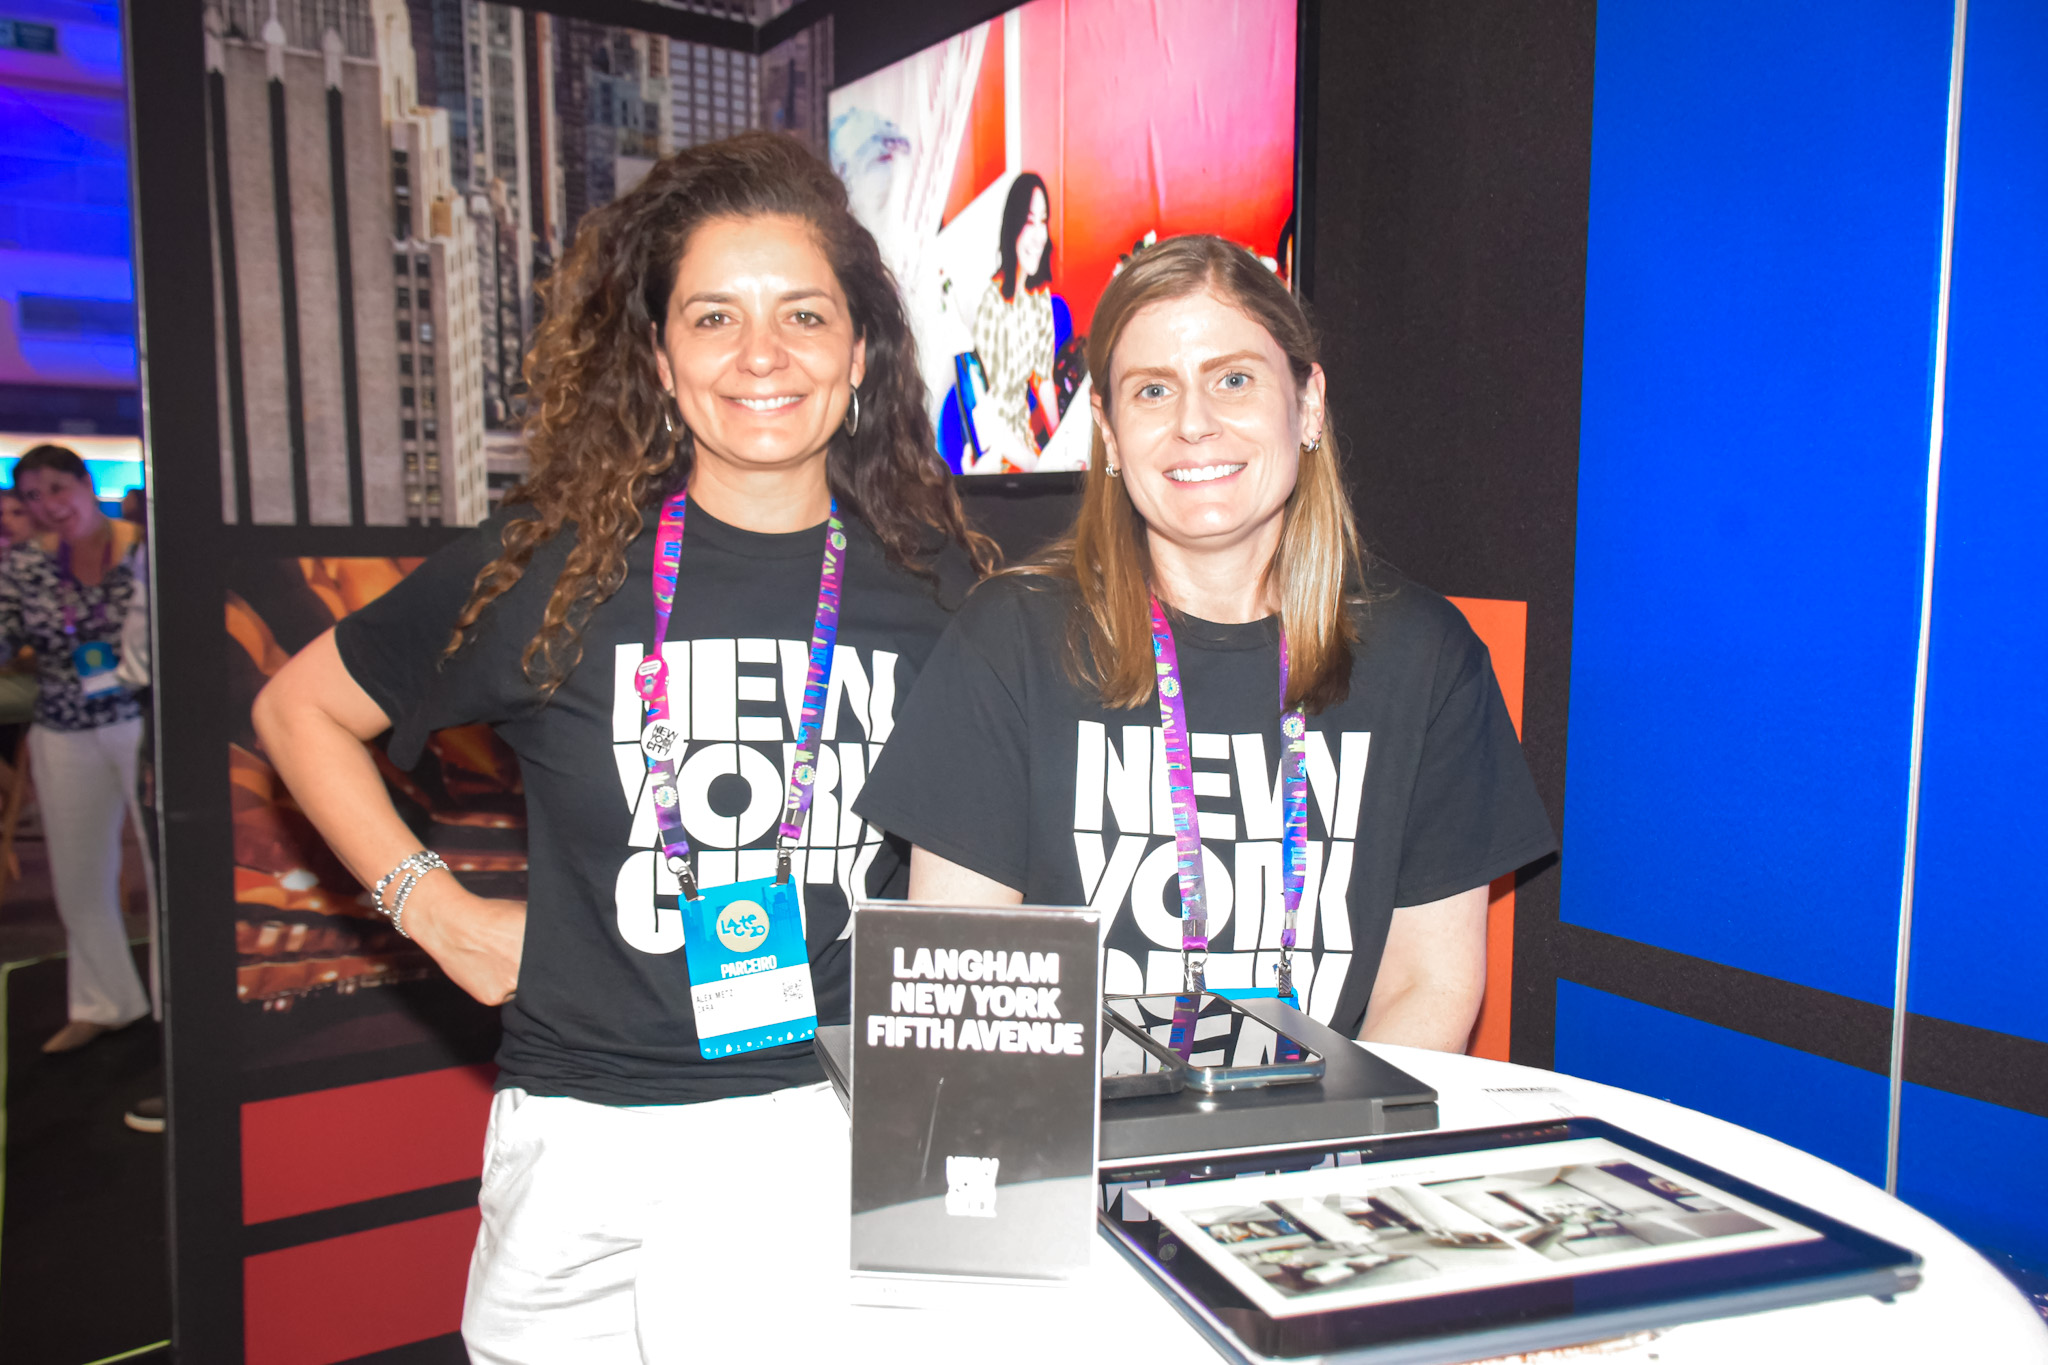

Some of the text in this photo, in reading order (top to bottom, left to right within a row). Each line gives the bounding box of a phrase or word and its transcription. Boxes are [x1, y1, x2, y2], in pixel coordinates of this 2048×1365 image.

[612, 638, 899, 742] NEW
[646, 741, 671, 756] CITY
[653, 724, 678, 740] NEW
[612, 742, 886, 849] YORK
[1073, 719, 1372, 840] NEW
[1073, 831, 1355, 951] YORK
[720, 955, 777, 978] PARCEIRO
[893, 946, 1060, 984] LANGHAM
[891, 981, 966, 1016] NEW
[969, 984, 1062, 1020] YORK
[867, 1015, 1085, 1056] FIFTH AVENUE
